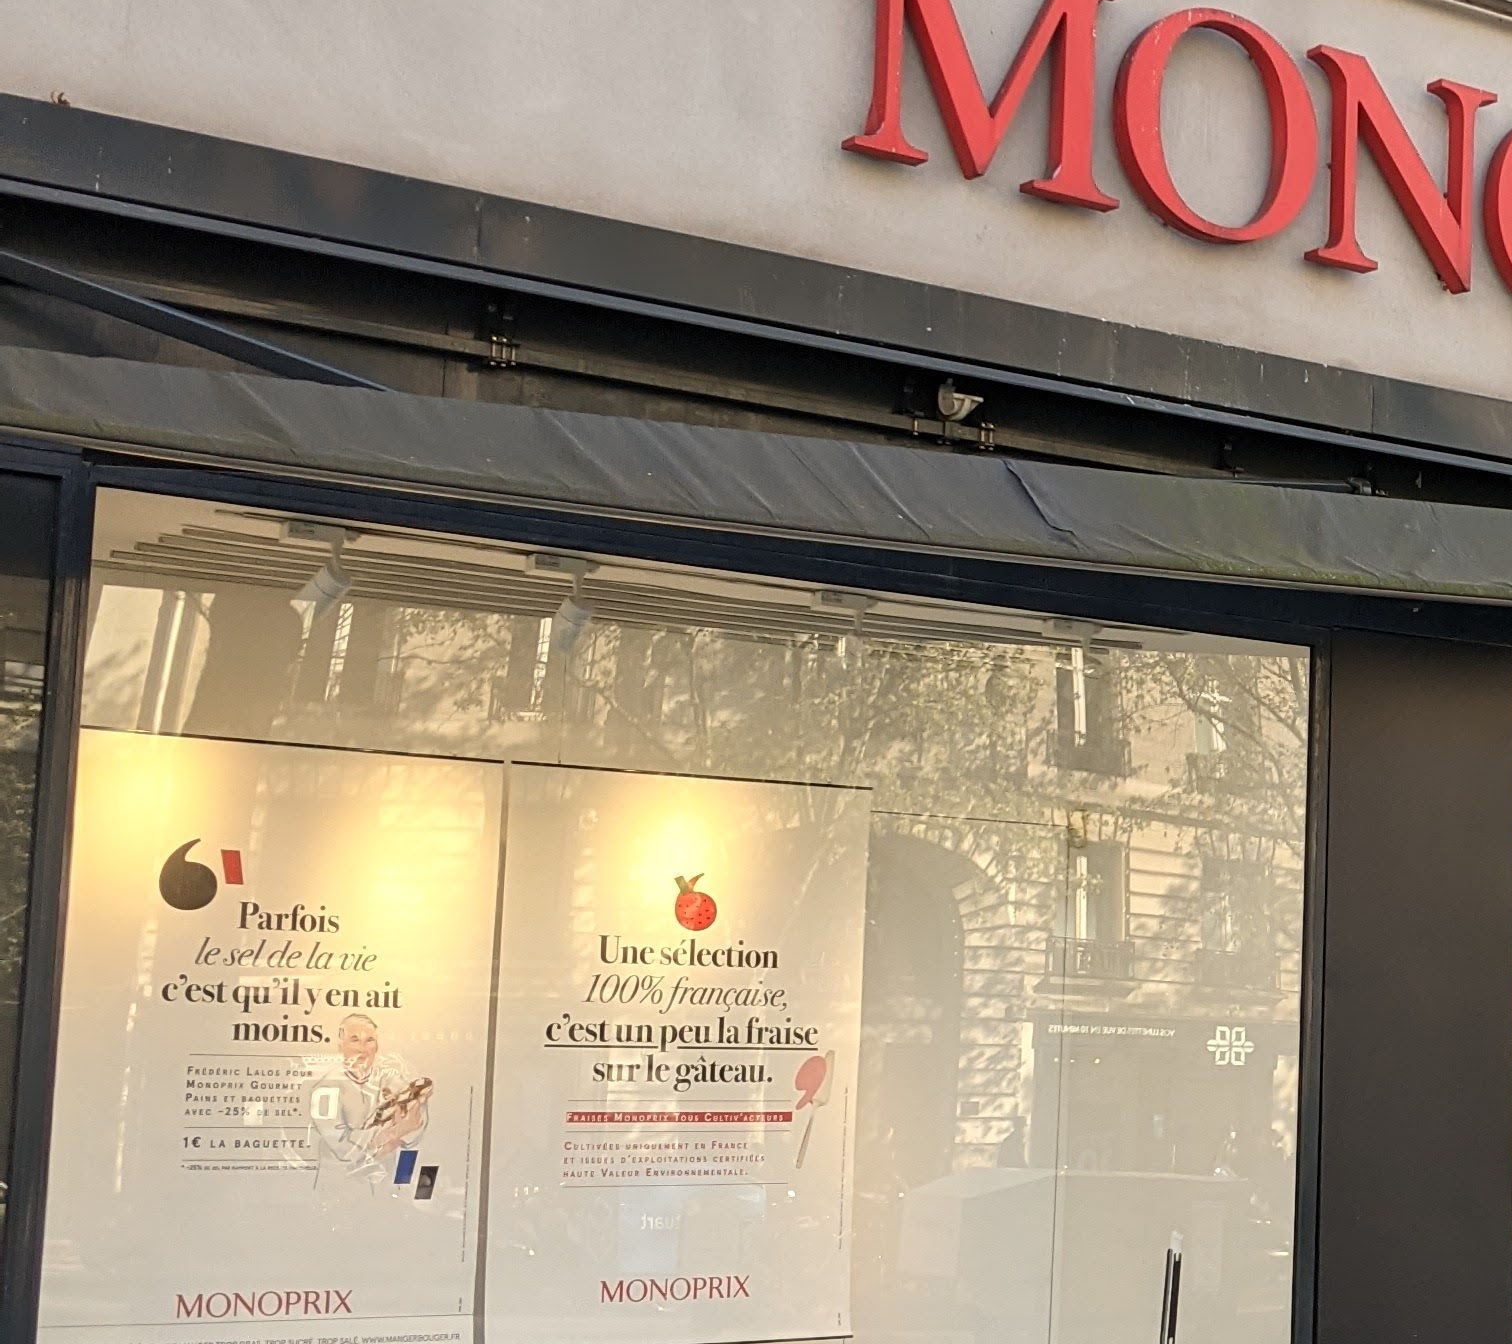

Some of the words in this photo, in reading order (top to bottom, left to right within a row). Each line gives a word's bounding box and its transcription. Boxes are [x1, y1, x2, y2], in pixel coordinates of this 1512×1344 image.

[236, 901, 340, 934] Parfois
[195, 937, 220, 966] le
[223, 939, 266, 968] sel
[267, 940, 301, 969] de
[306, 941, 333, 971] la
[339, 946, 377, 972] vie
[599, 934, 655, 965] Une
[660, 939, 779, 969] sélection
[161, 974, 227, 1003] c'est
[233, 977, 300, 1013] qu'il
[304, 987, 323, 1015] y
[325, 989, 360, 1008] en
[366, 981, 402, 1009] ait
[581, 973, 666, 1005] 100%
[659, 976, 788, 1014] française,
[232, 1014, 331, 1044] moins.
[545, 1013, 611, 1043] c'est
[615, 1019, 653, 1043] un
[658, 1022, 713, 1052] peu
[717, 1017, 741, 1044] la
[745, 1017, 819, 1046] fraise
[186, 1079, 244, 1089] MONOPRIX
[592, 1062, 640, 1083] sur
[646, 1054, 670, 1083] le
[673, 1055, 773, 1092] gâteau.
[614, 1113, 669, 1122] MONOPRIX
[182, 1136, 201, 1148] 1€
[210, 1138, 226, 1148] LA
[234, 1138, 312, 1149] BAGUETTE.
[176, 1289, 353, 1319] MONOPRIX
[600, 1275, 750, 1303] MONOPRIX
